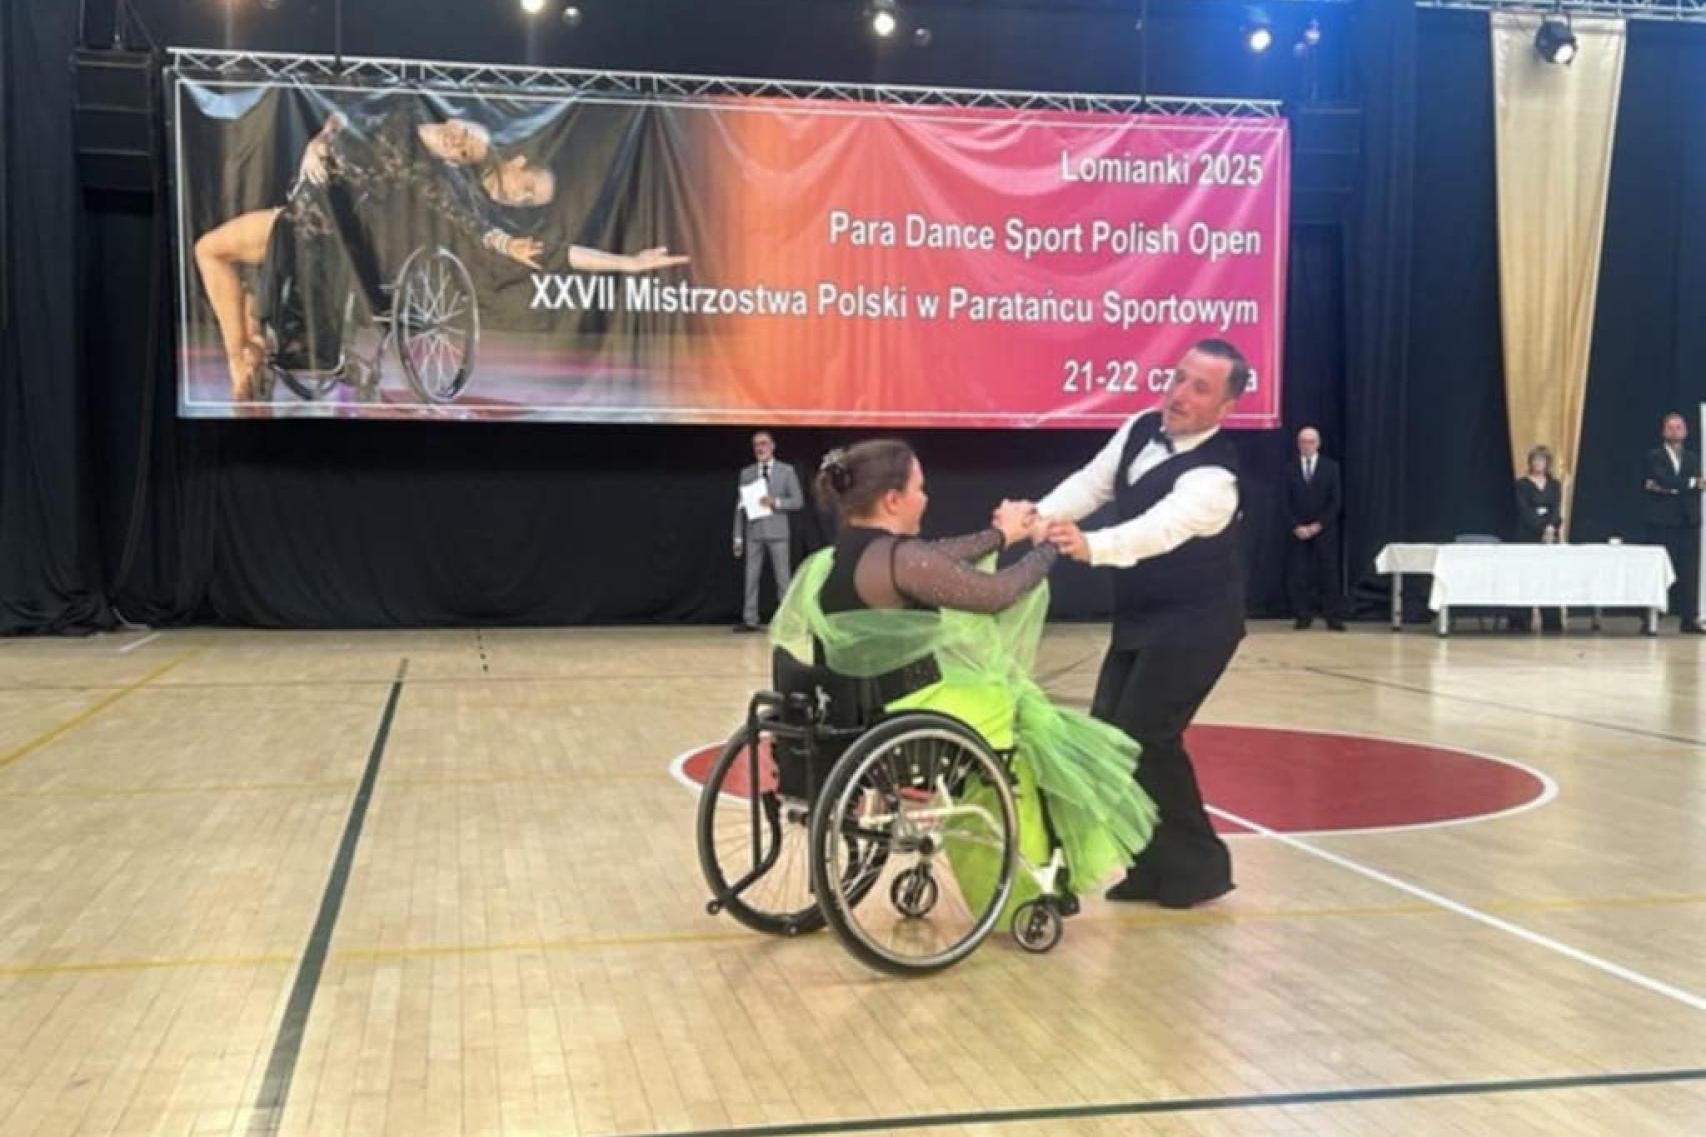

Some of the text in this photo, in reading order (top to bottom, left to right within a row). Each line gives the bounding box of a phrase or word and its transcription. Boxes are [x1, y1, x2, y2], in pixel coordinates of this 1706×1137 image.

[1199, 153, 1263, 186] 2025
[829, 210, 1262, 262] Para Dance Sport Polish Open
[530, 274, 1259, 331] XXVII Mistrzostwa Polski w Paratańcu Sportowym
[1063, 360, 1138, 392] 21-22
